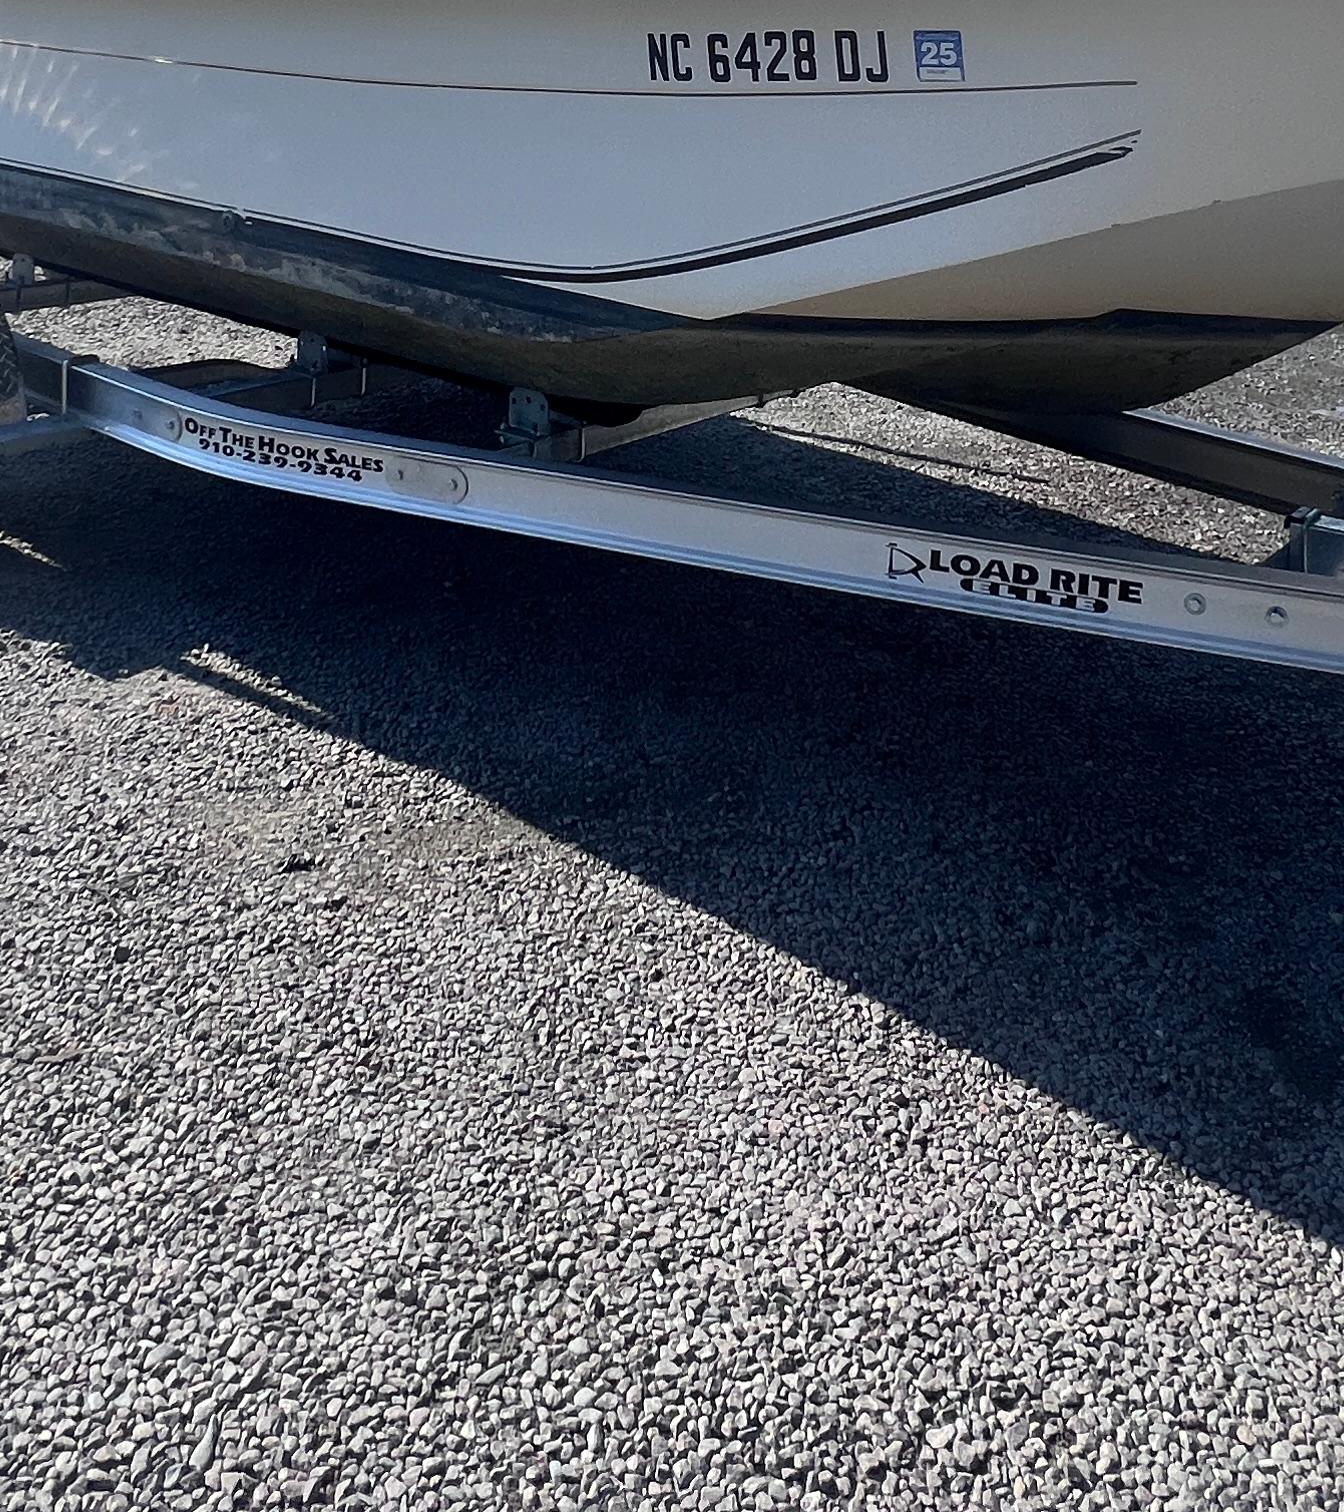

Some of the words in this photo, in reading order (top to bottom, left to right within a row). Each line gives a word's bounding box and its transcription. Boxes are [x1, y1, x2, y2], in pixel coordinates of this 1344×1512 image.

[647, 31, 693, 82] NC
[706, 29, 818, 83] 6428
[834, 29, 890, 83] DJ
[920, 41, 958, 66] 25
[198, 438, 363, 482] 910-239-9344
[929, 549, 1040, 586] LOAD
[1050, 567, 1144, 605] RITE
[972, 578, 1097, 613] ELITE
